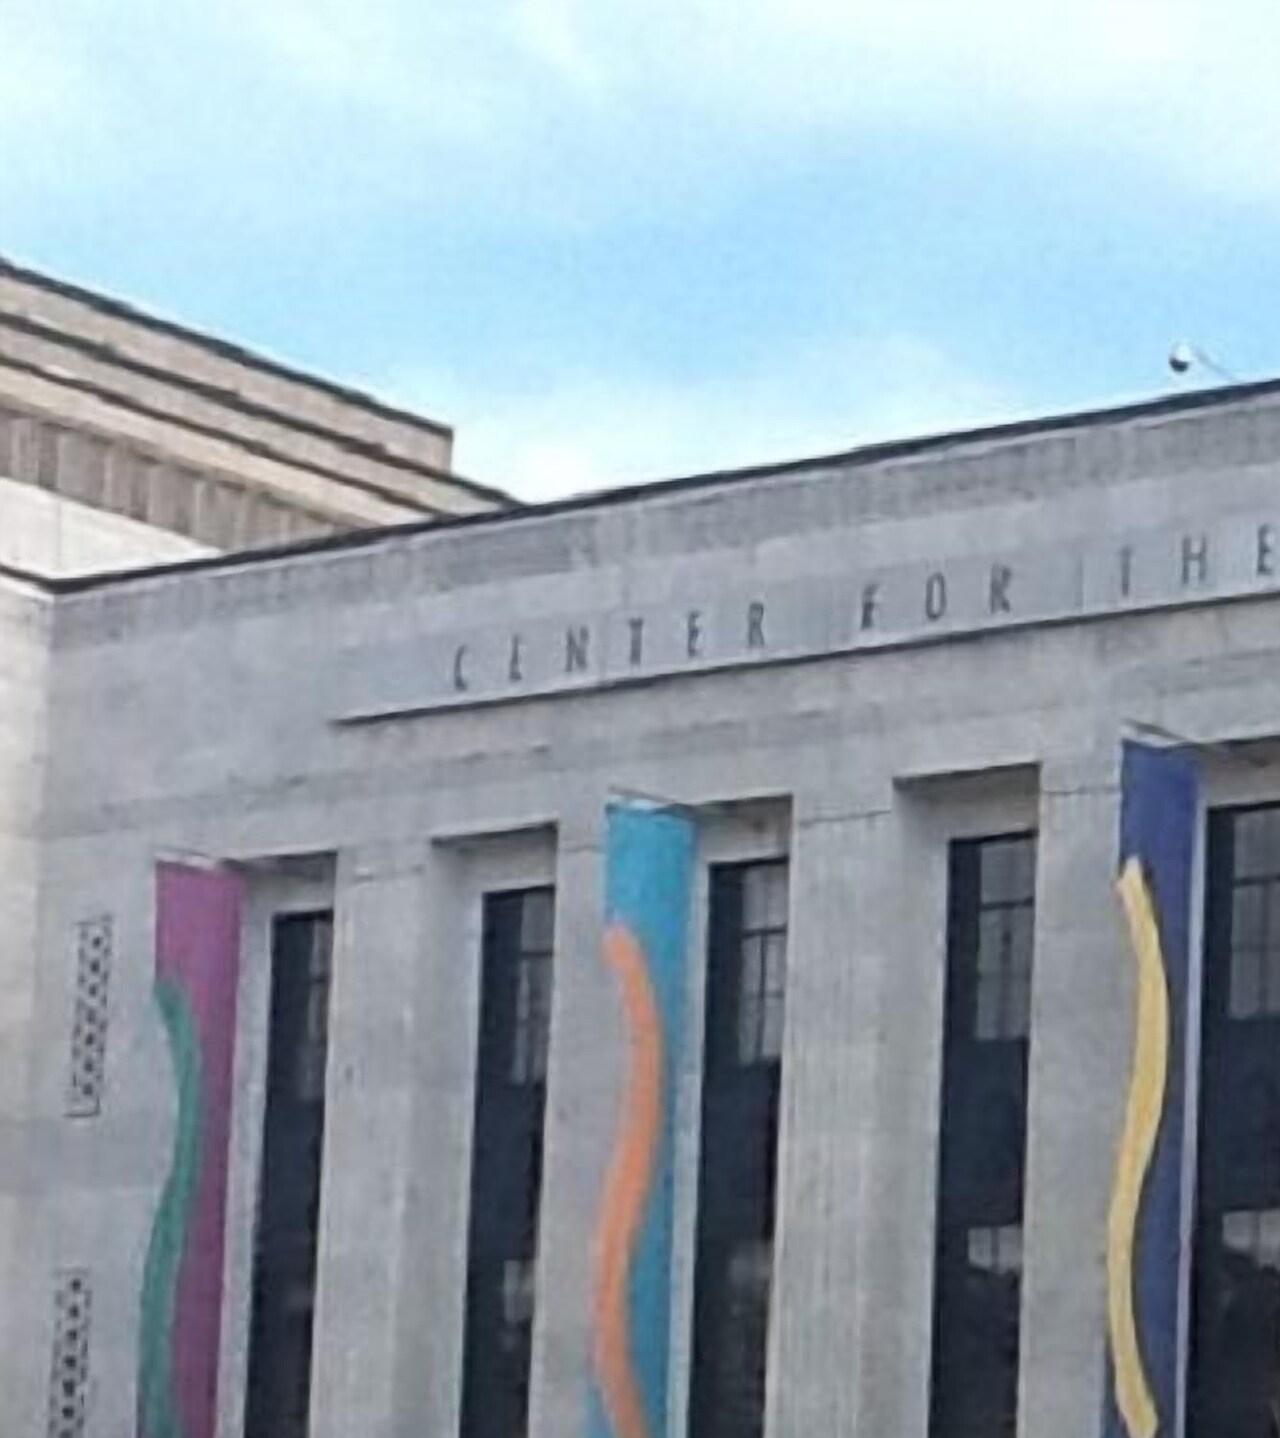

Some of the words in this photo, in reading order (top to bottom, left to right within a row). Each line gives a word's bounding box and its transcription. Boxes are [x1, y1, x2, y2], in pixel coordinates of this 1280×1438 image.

[452, 602, 766, 692] CENTER
[860, 562, 1012, 631] FOR
[1119, 523, 1276, 598] THE
